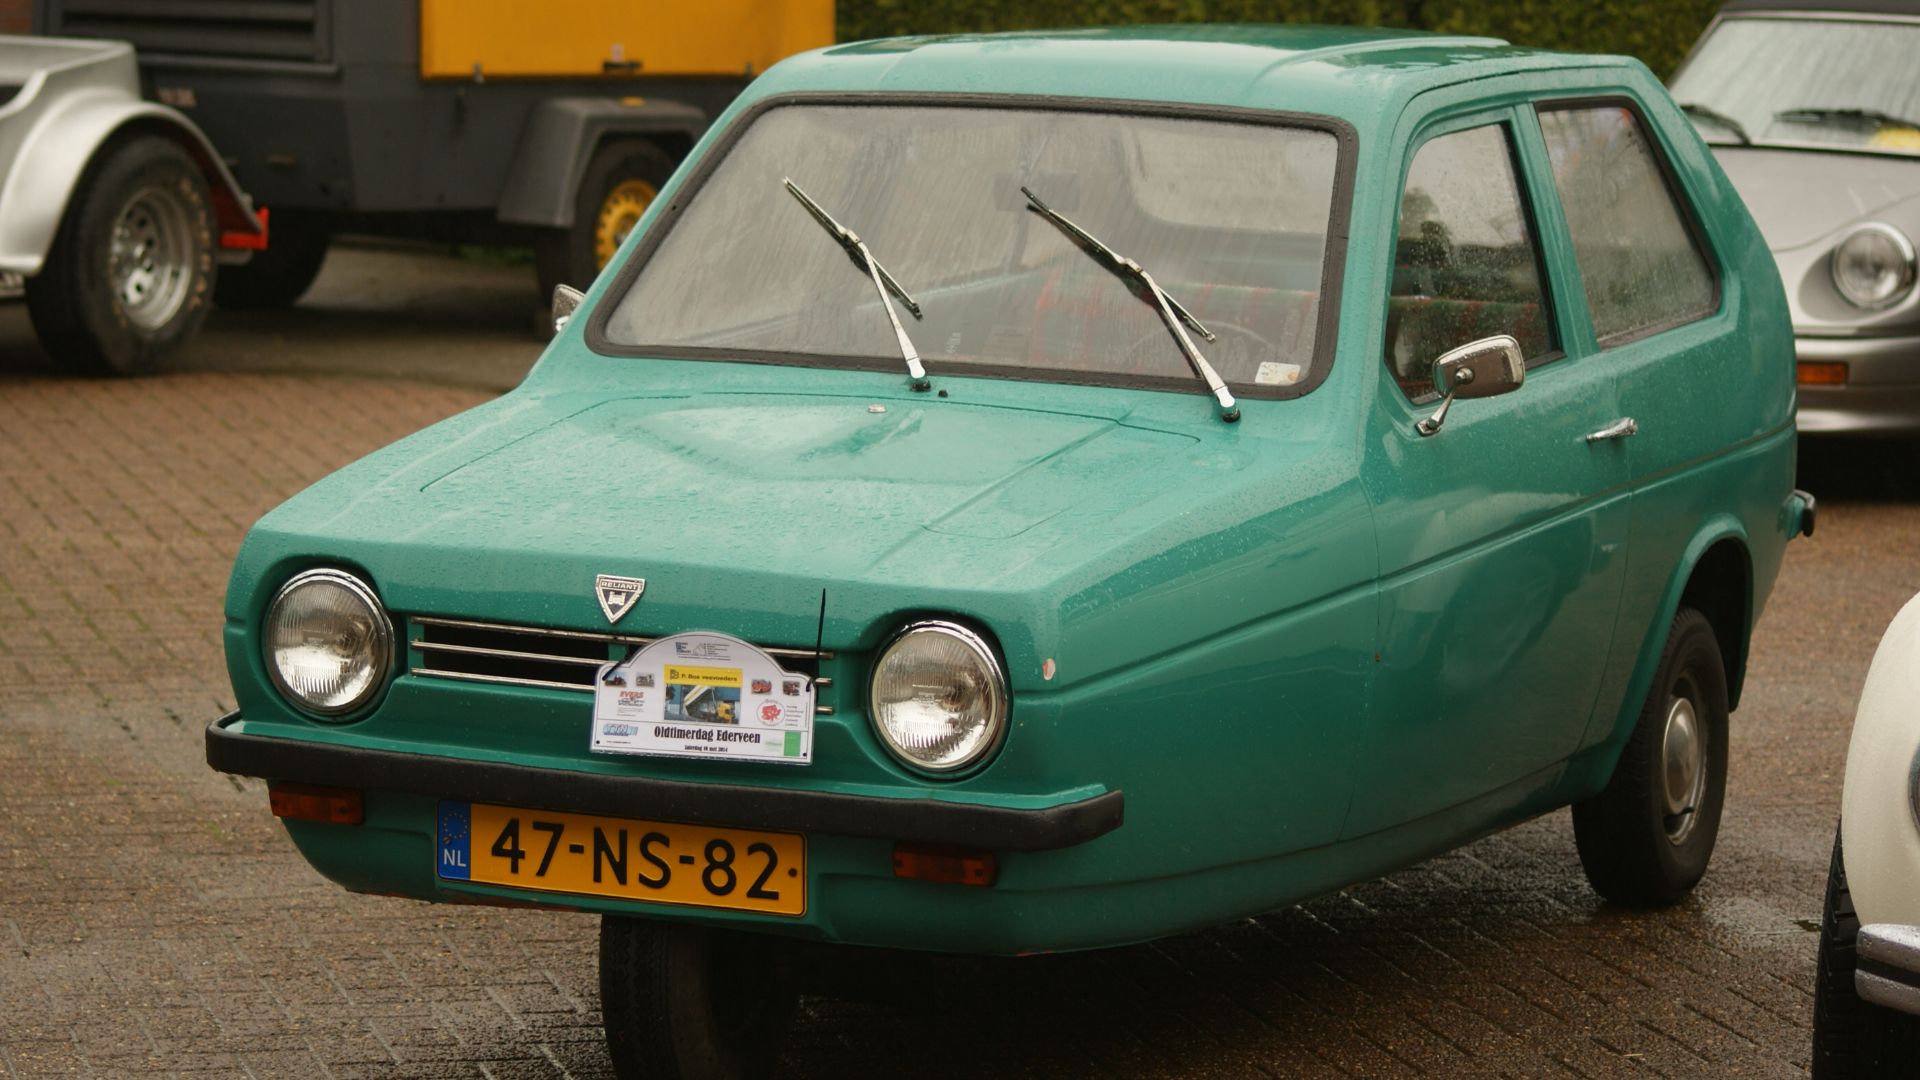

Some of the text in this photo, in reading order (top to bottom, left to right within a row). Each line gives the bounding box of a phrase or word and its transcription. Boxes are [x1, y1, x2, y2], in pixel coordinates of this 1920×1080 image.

[601, 580, 638, 590] RELIANT
[654, 726, 714, 742] Oldtimerdag
[717, 730, 761, 744] Ederveen
[443, 848, 466, 867] NL
[491, 818, 779, 901] 47-NS-82
